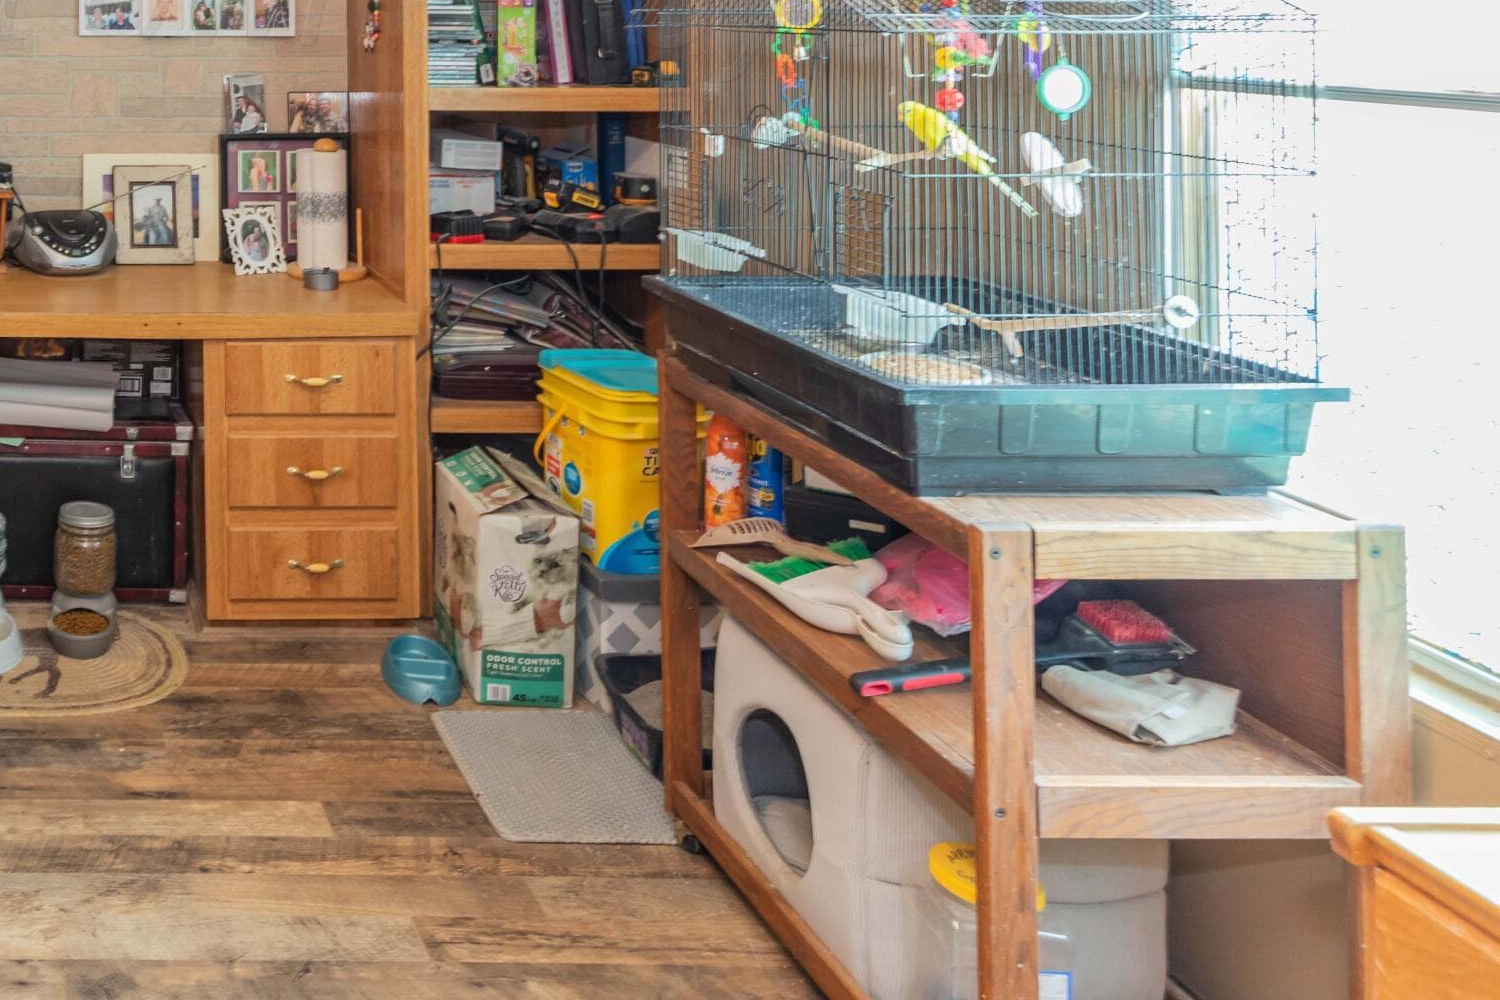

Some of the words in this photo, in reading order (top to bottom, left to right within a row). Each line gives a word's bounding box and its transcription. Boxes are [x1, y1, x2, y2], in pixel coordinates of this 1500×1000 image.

[489, 565, 523, 583] Special
[490, 580, 527, 602] Kitty
[486, 654, 515, 664] ODOR
[517, 657, 562, 666] CONTROL
[486, 663, 517, 672] FRESH
[512, 693, 527, 702] 45
